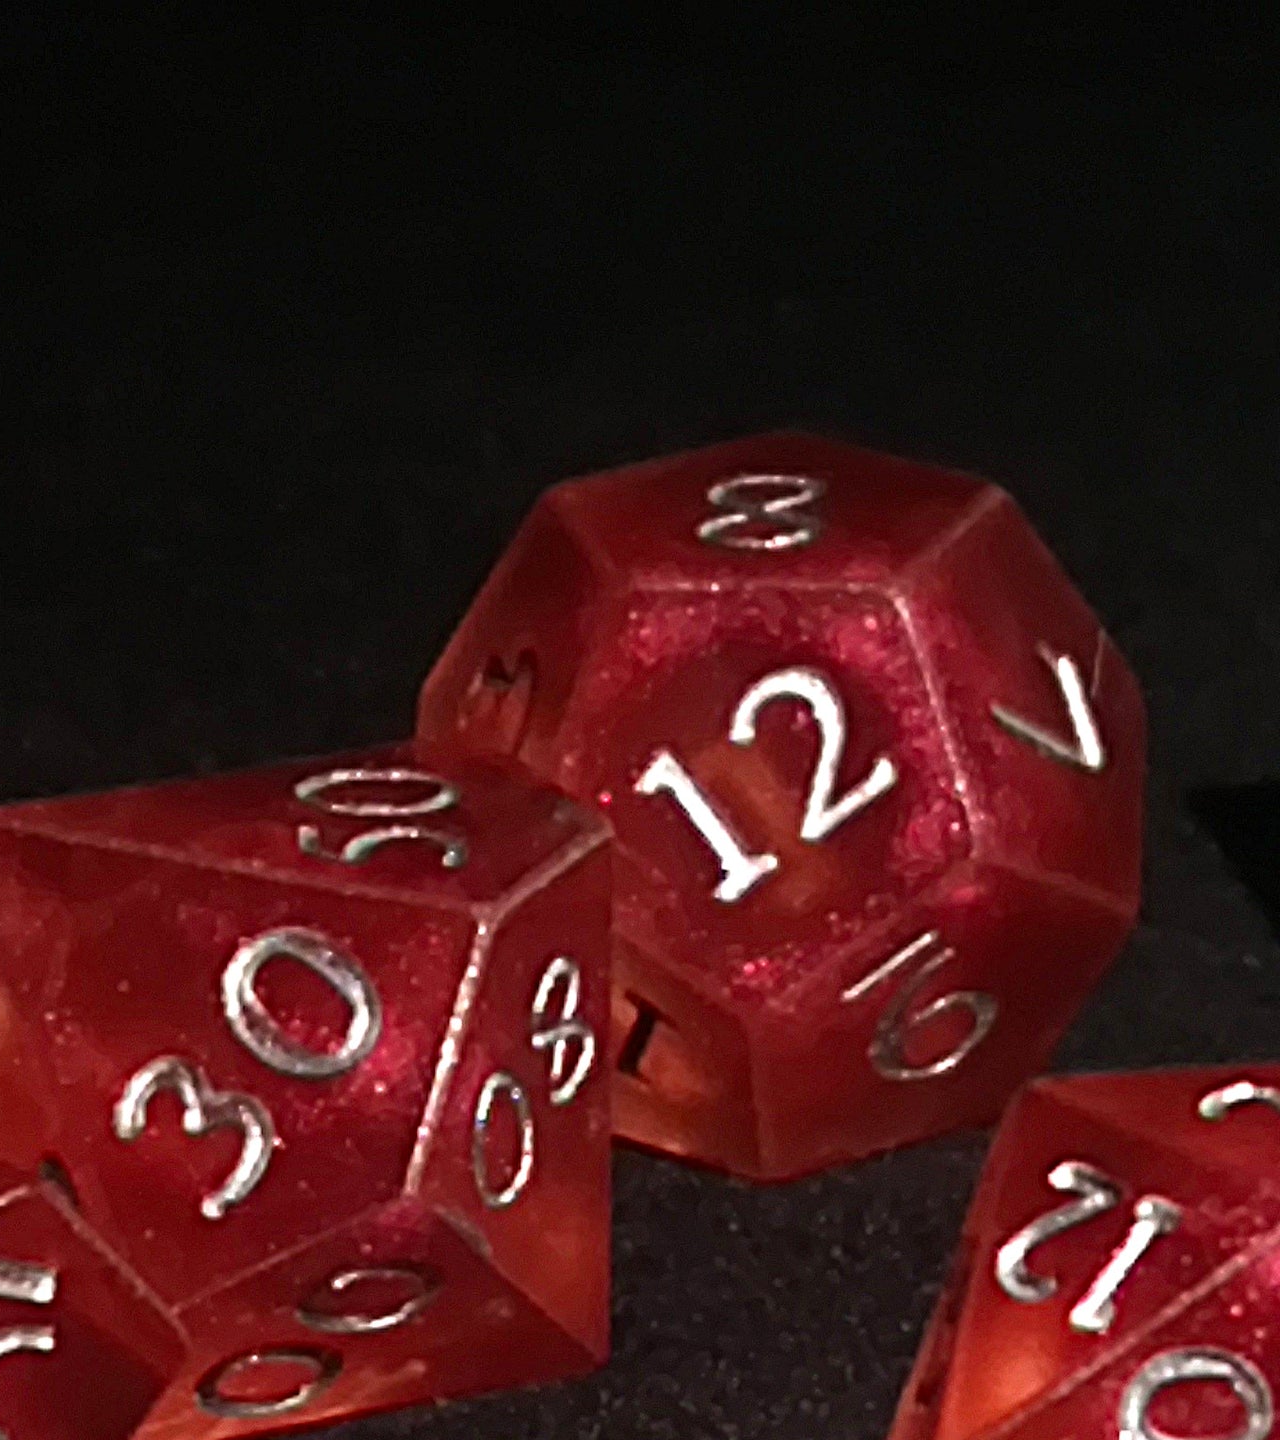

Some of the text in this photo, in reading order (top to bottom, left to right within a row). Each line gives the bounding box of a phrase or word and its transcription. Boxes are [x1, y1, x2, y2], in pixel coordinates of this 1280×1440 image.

[696, 474, 824, 551] 8
[633, 667, 898, 904] 12
[114, 925, 382, 1221] 30
